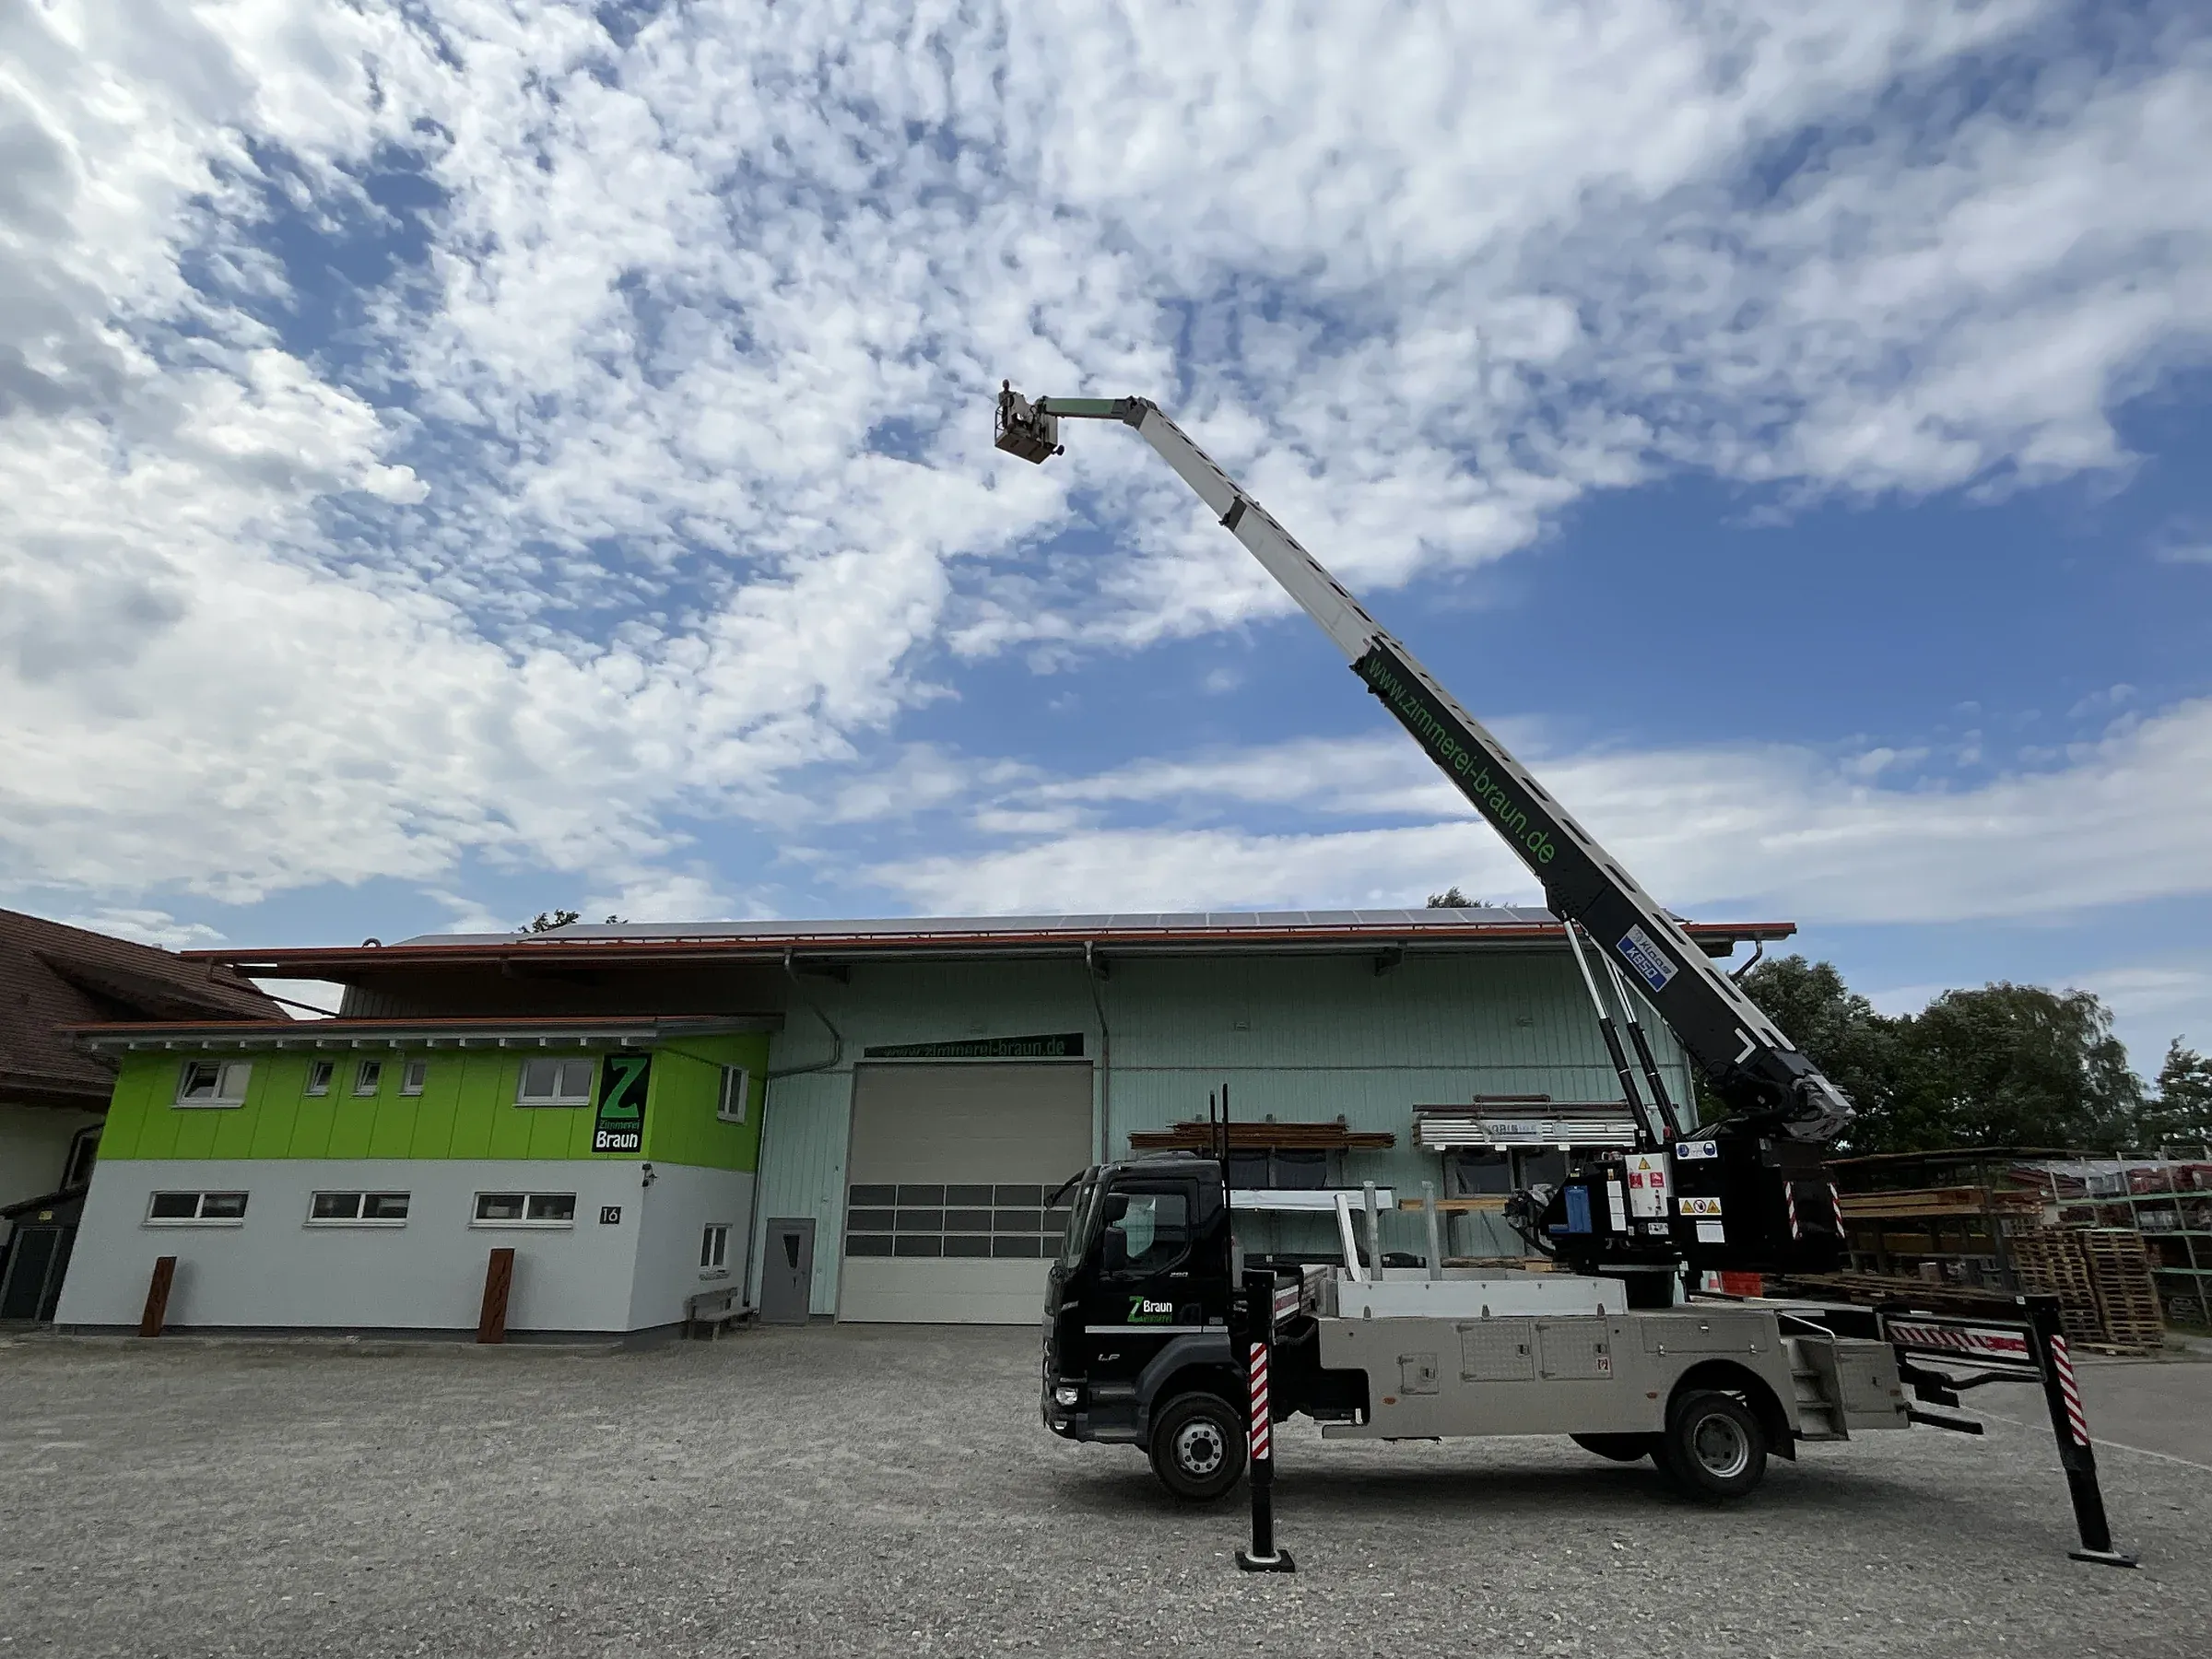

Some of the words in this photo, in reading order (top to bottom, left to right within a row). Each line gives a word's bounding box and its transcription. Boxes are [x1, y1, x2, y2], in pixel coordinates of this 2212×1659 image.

[1368, 657, 1556, 864] www.zimmerei-braun.de
[601, 1057, 648, 1118] Z
[599, 1119, 640, 1130] Zimmerei
[595, 1130, 639, 1148] Braun
[603, 1207, 618, 1222] 16
[1143, 1300, 1173, 1312] Braun
[1098, 1353, 1121, 1361] LF
